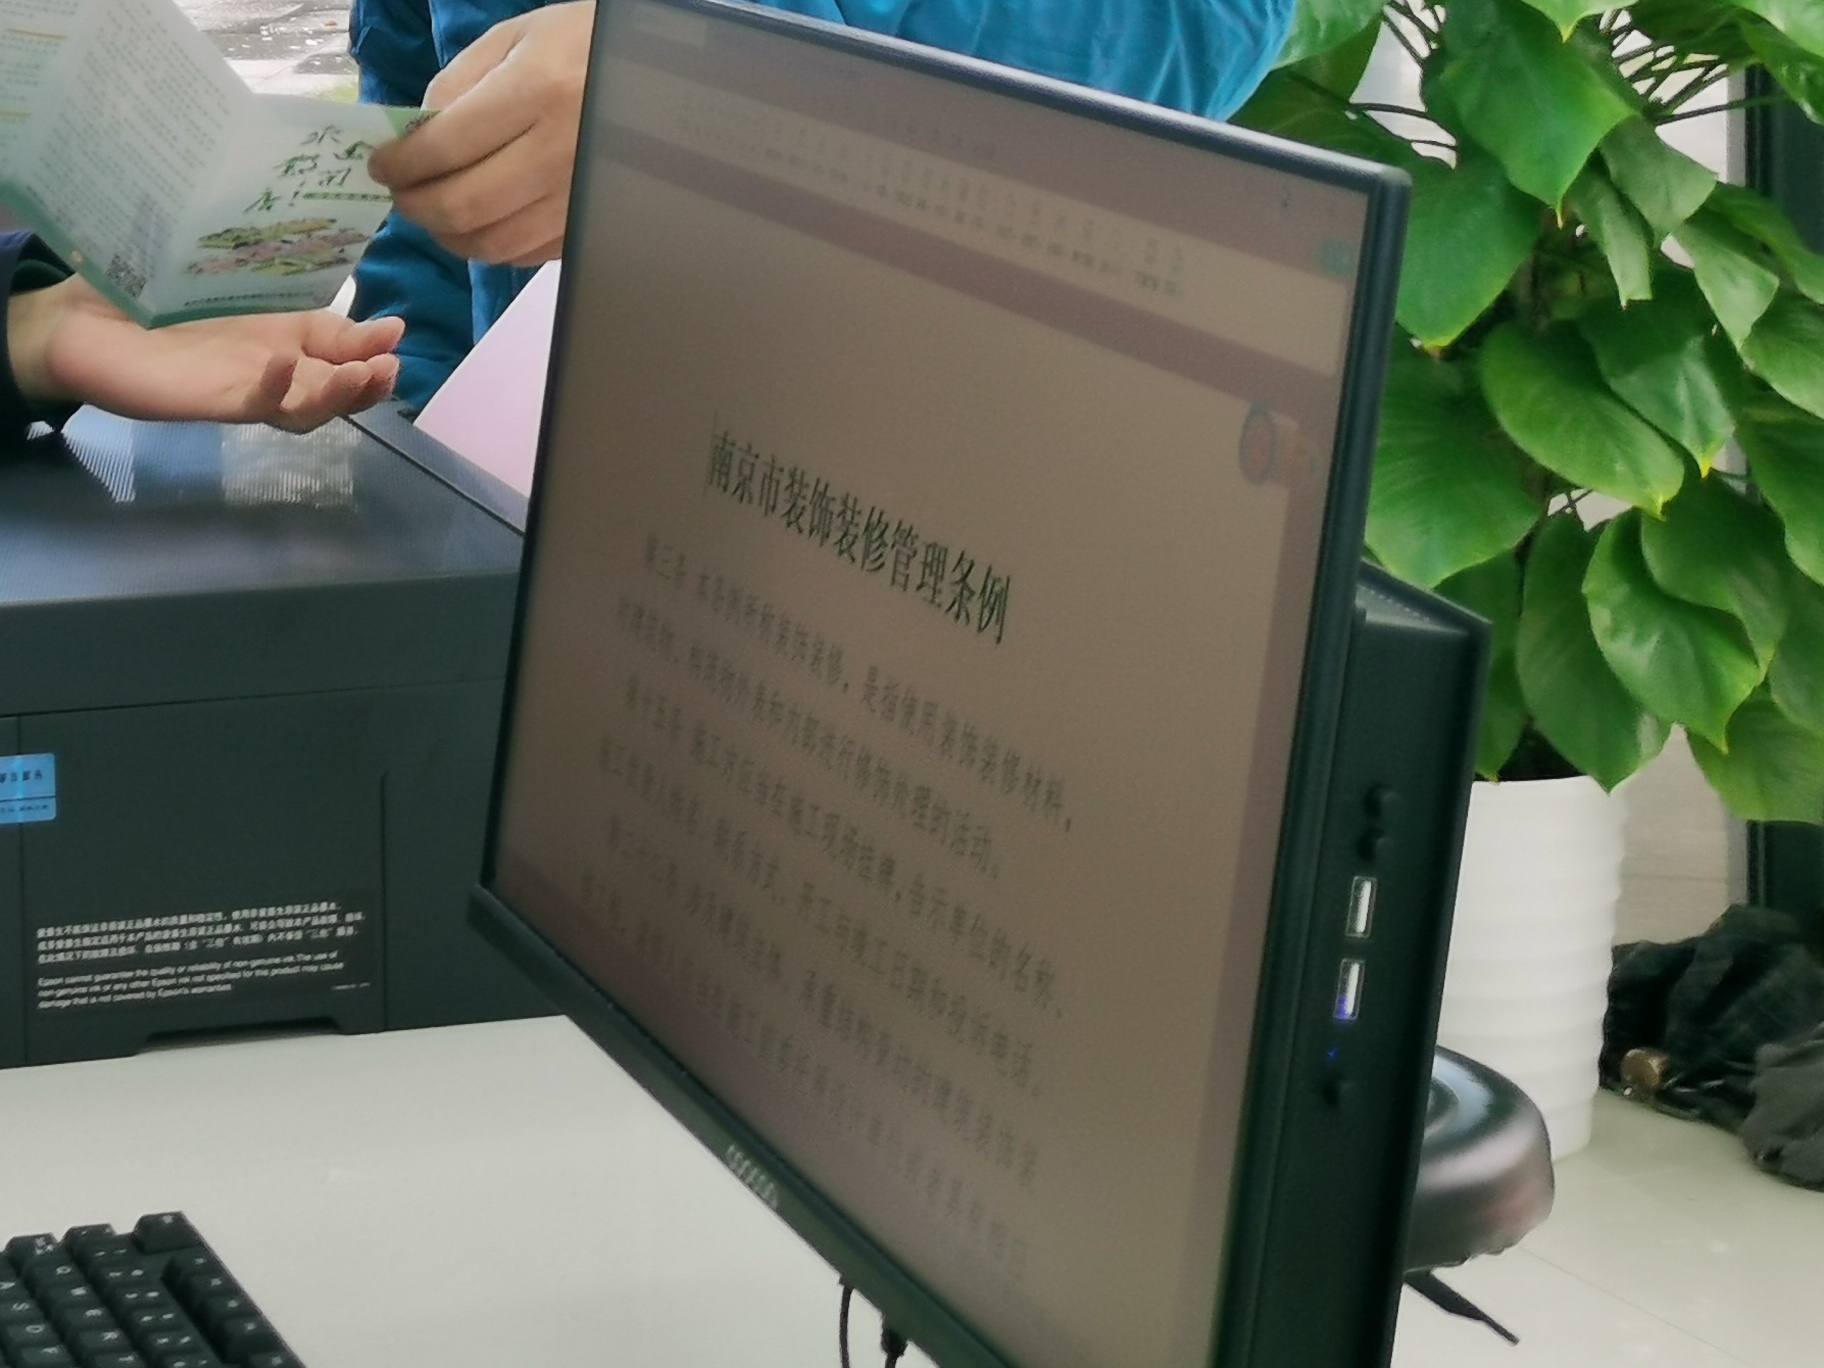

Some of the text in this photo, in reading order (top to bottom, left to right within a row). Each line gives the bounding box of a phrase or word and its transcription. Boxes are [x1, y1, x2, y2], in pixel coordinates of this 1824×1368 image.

[708, 429, 1012, 645] 南京市装饰装修管理条例
[38, 975, 63, 987] Epson
[151, 977, 176, 988] Epson
